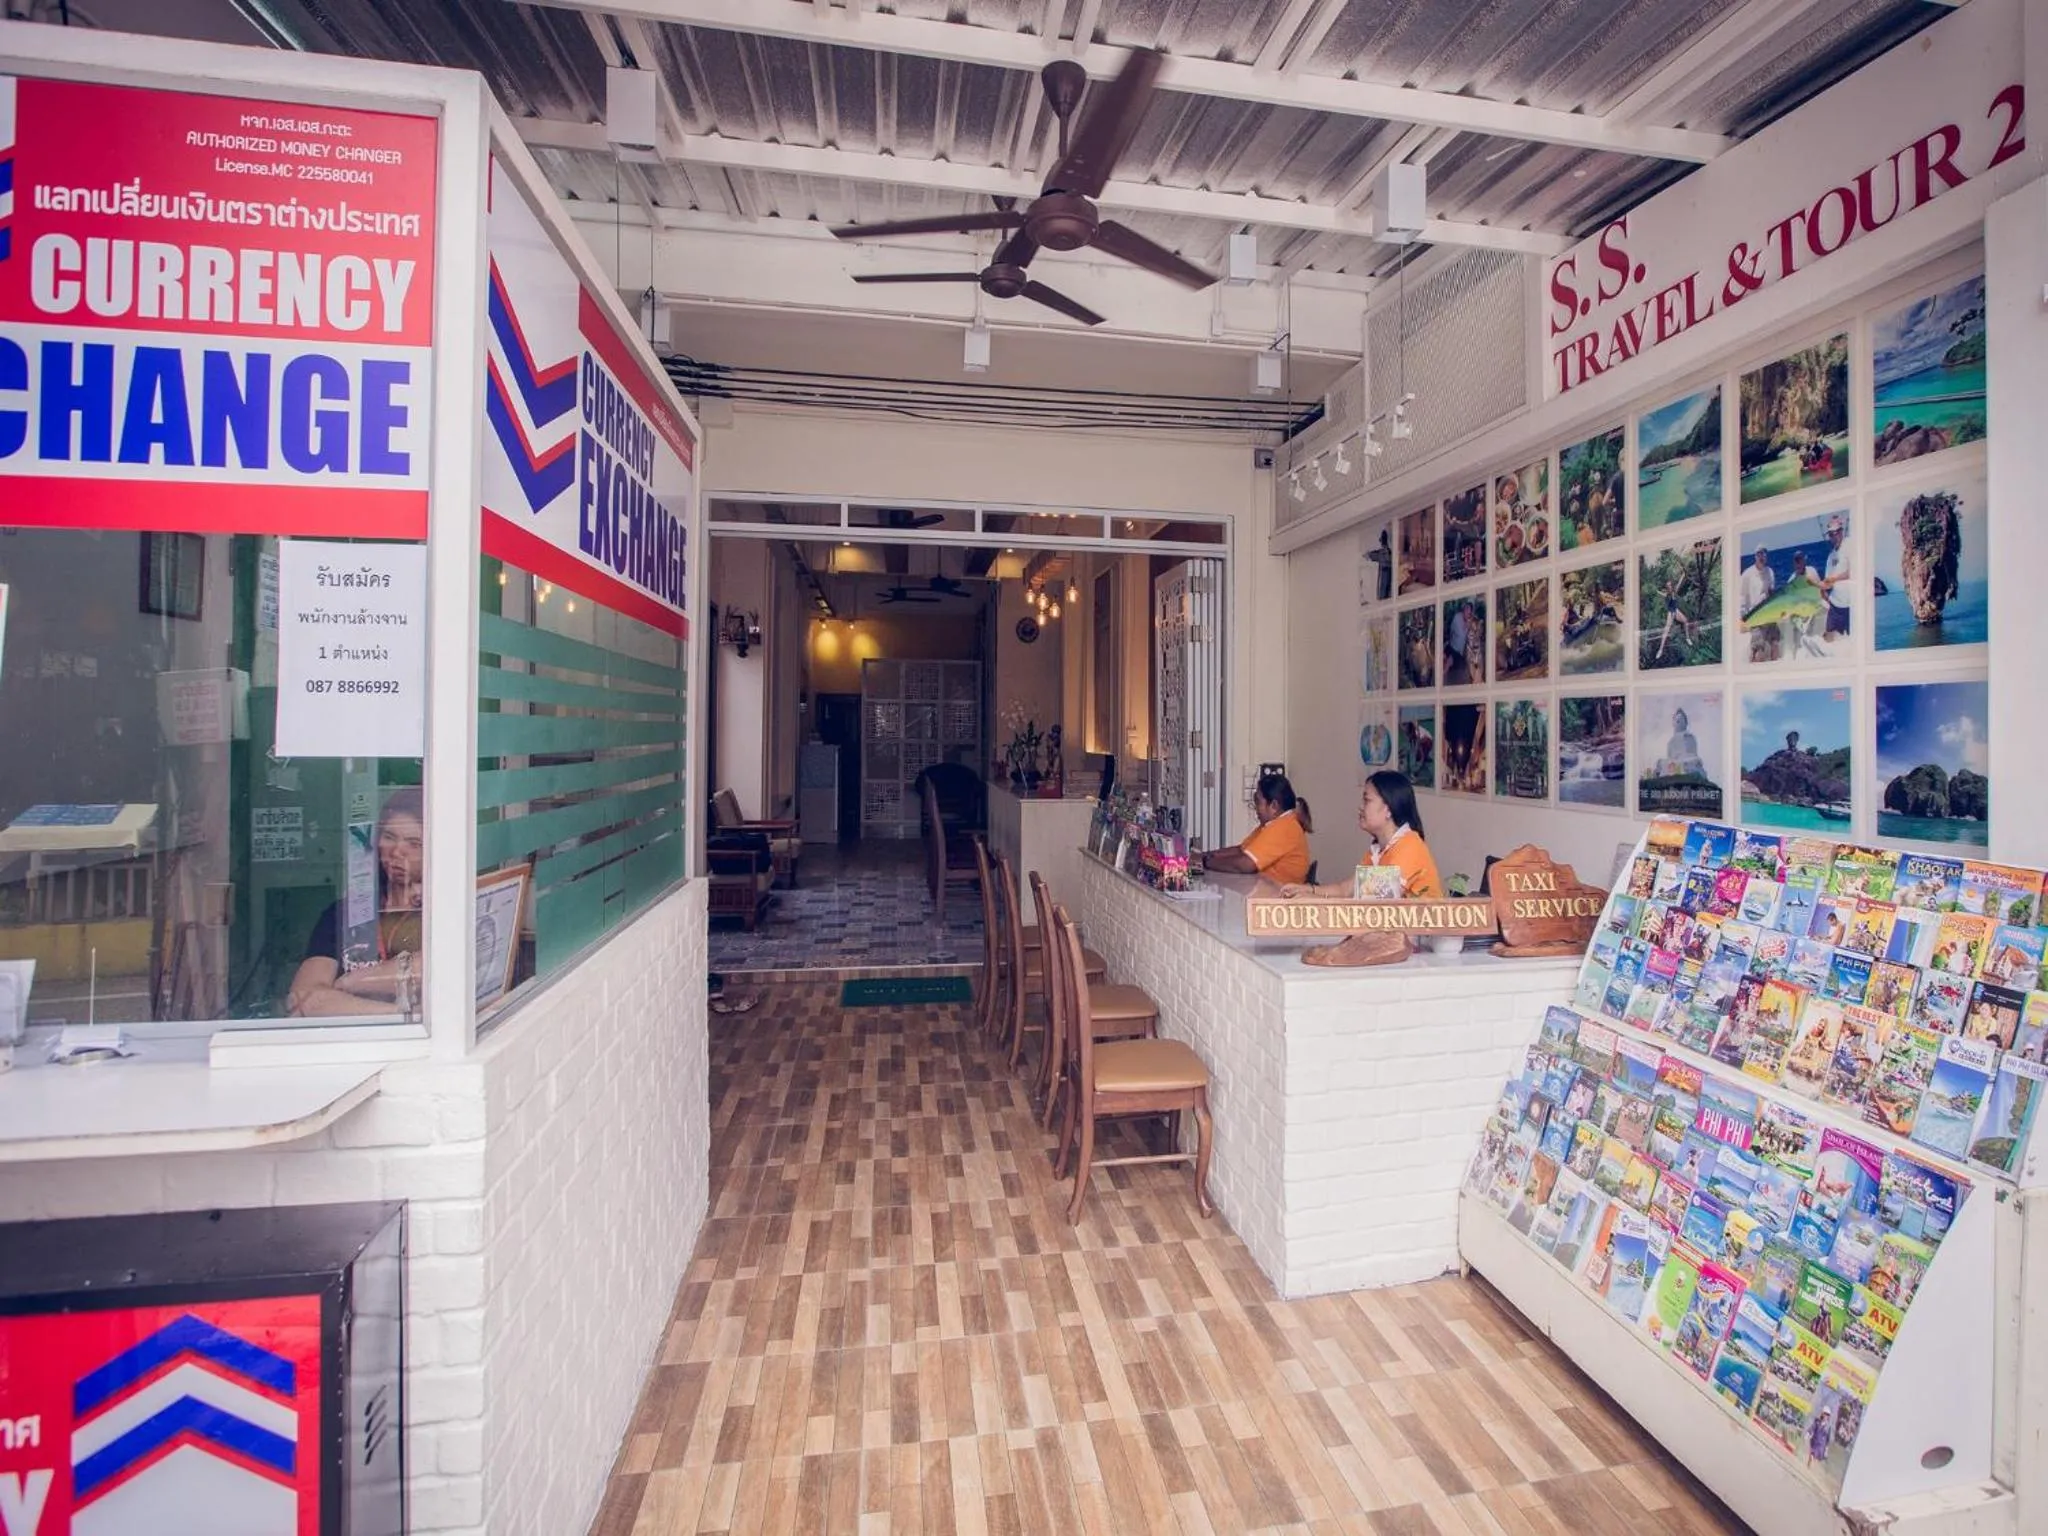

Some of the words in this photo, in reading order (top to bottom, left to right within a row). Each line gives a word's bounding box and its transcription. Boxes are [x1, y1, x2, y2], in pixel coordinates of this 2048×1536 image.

[186, 131, 278, 154] AUTHORIZED
[280, 140, 331, 158] MONEY
[335, 145, 402, 165] CHANGER
[297, 165, 374, 185] 225580041
[33, 178, 421, 237] แลกเปลี่ยนเงินตราต่างประเทศ
[1553, 270, 1715, 395] TRAVEL
[1721, 241, 1767, 308] &
[1766, 123, 1970, 279] TOUR
[1987, 84, 2026, 171] 2
[30, 232, 416, 333] CURRENCY
[581, 349, 656, 489] CURRENCY
[579, 426, 688, 611] EXCHANGE
[316, 565, 391, 588] รับสมัคร
[298, 607, 408, 625] พนักงานล้างจาน
[318, 646, 327, 659] 1
[332, 644, 389, 661] ตำแหน่ง
[305, 679, 333, 694] 087
[337, 679, 400, 694] 8866992
[1505, 872, 1557, 892] TAXI
[1256, 904, 1322, 929] TOUR
[1327, 904, 1489, 929] INFORMATION
[1513, 897, 1601, 918] SERVICE
[1700, 1107, 1723, 1137] PHI
[1725, 1117, 1747, 1148] PHI
[1869, 1308, 1899, 1334] ATV
[1797, 1341, 1825, 1367] ATV
